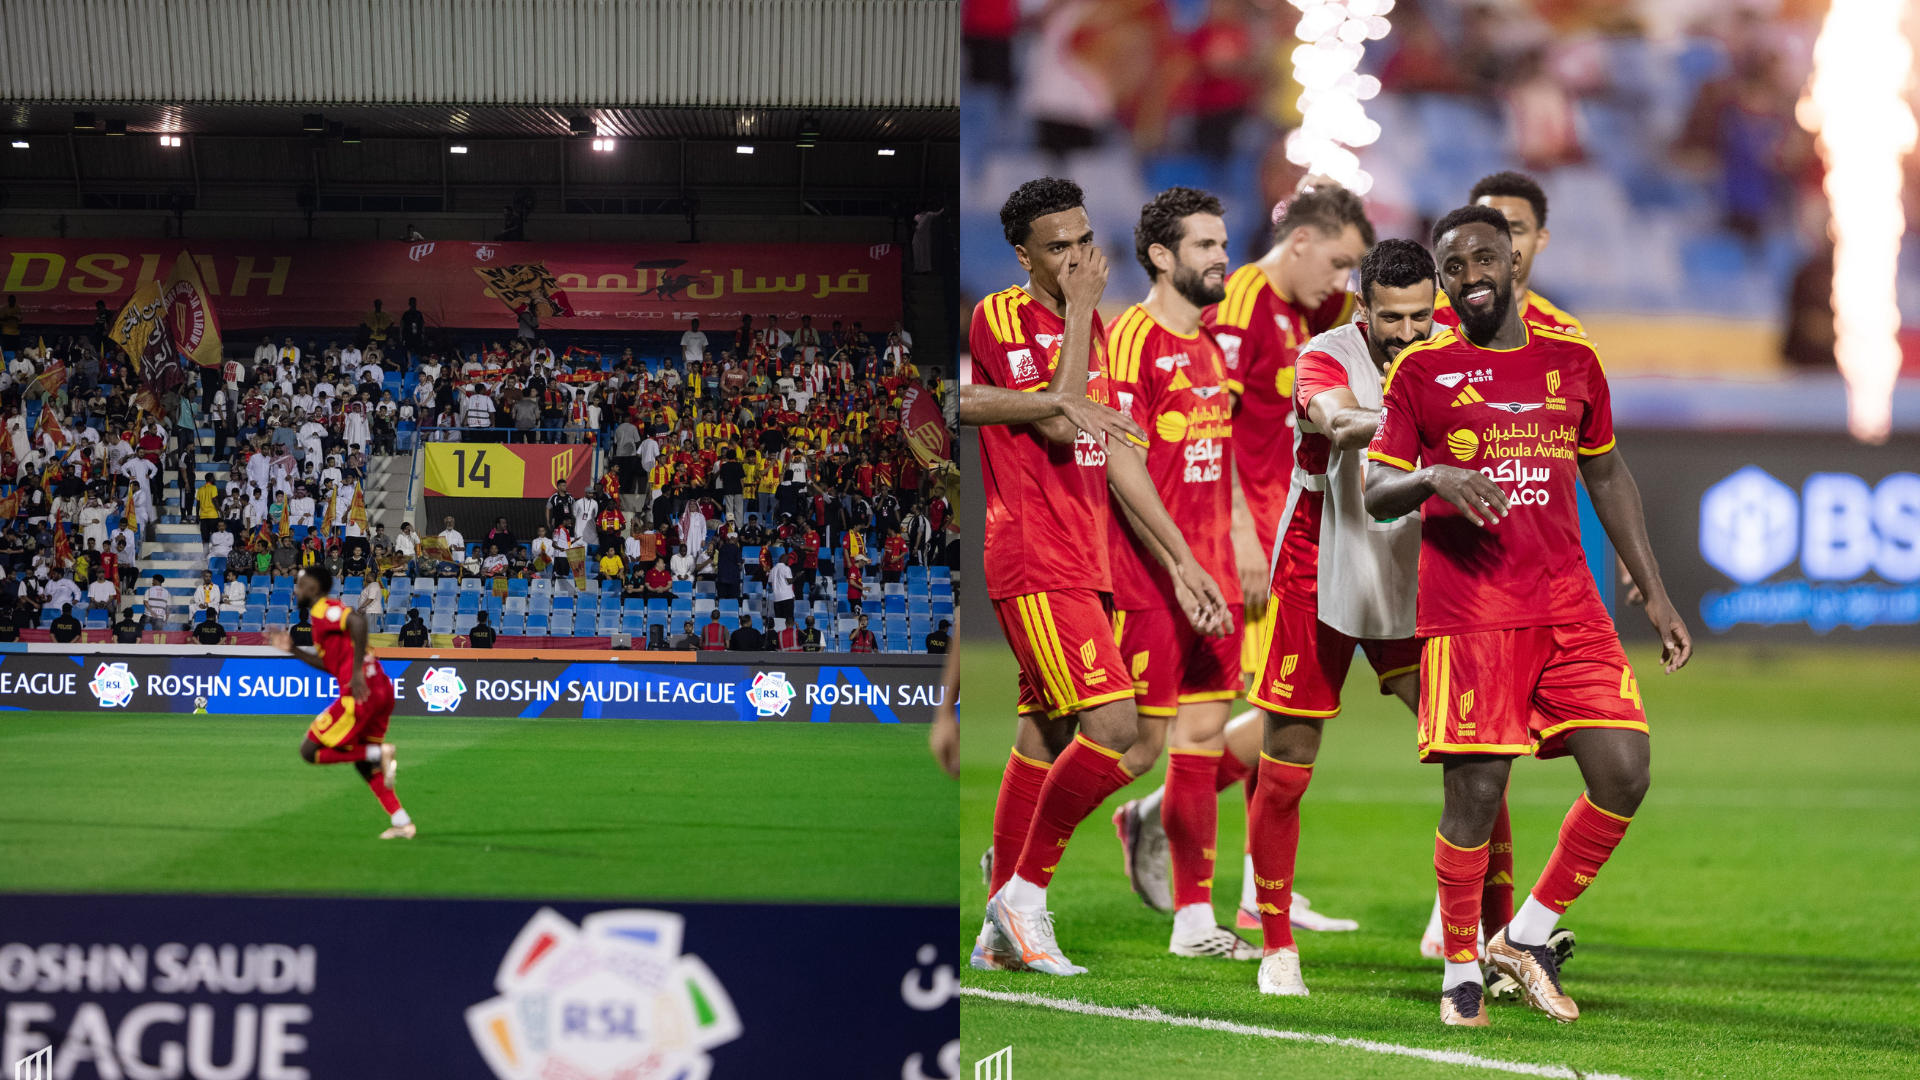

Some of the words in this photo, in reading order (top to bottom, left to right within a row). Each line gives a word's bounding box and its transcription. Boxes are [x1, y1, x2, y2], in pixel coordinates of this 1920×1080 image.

[1483, 423, 1539, 443] للطيران
[1483, 442, 1532, 460] Aloula
[1533, 442, 1575, 460] Aviation
[453, 450, 491, 488] 14
[0, 673, 76, 695] EAGUE
[106, 681, 121, 689] RSL
[148, 674, 231, 697] ROSHN
[239, 675, 310, 697] SAUDI
[317, 676, 405, 699] LEE
[434, 685, 449, 694] RSL
[475, 679, 560, 702] ROSHN
[567, 681, 639, 703] SAUDI
[646, 682, 735, 704] LEAGUE
[763, 689, 779, 698] RSL
[806, 684, 890, 706] ROSHN
[1620, 665, 1641, 710] 4
[1254, 874, 1285, 890] 1935
[1447, 923, 1477, 936] 1935
[153, 943, 317, 993] SAUDI
[561, 1001, 642, 1039] RSL
